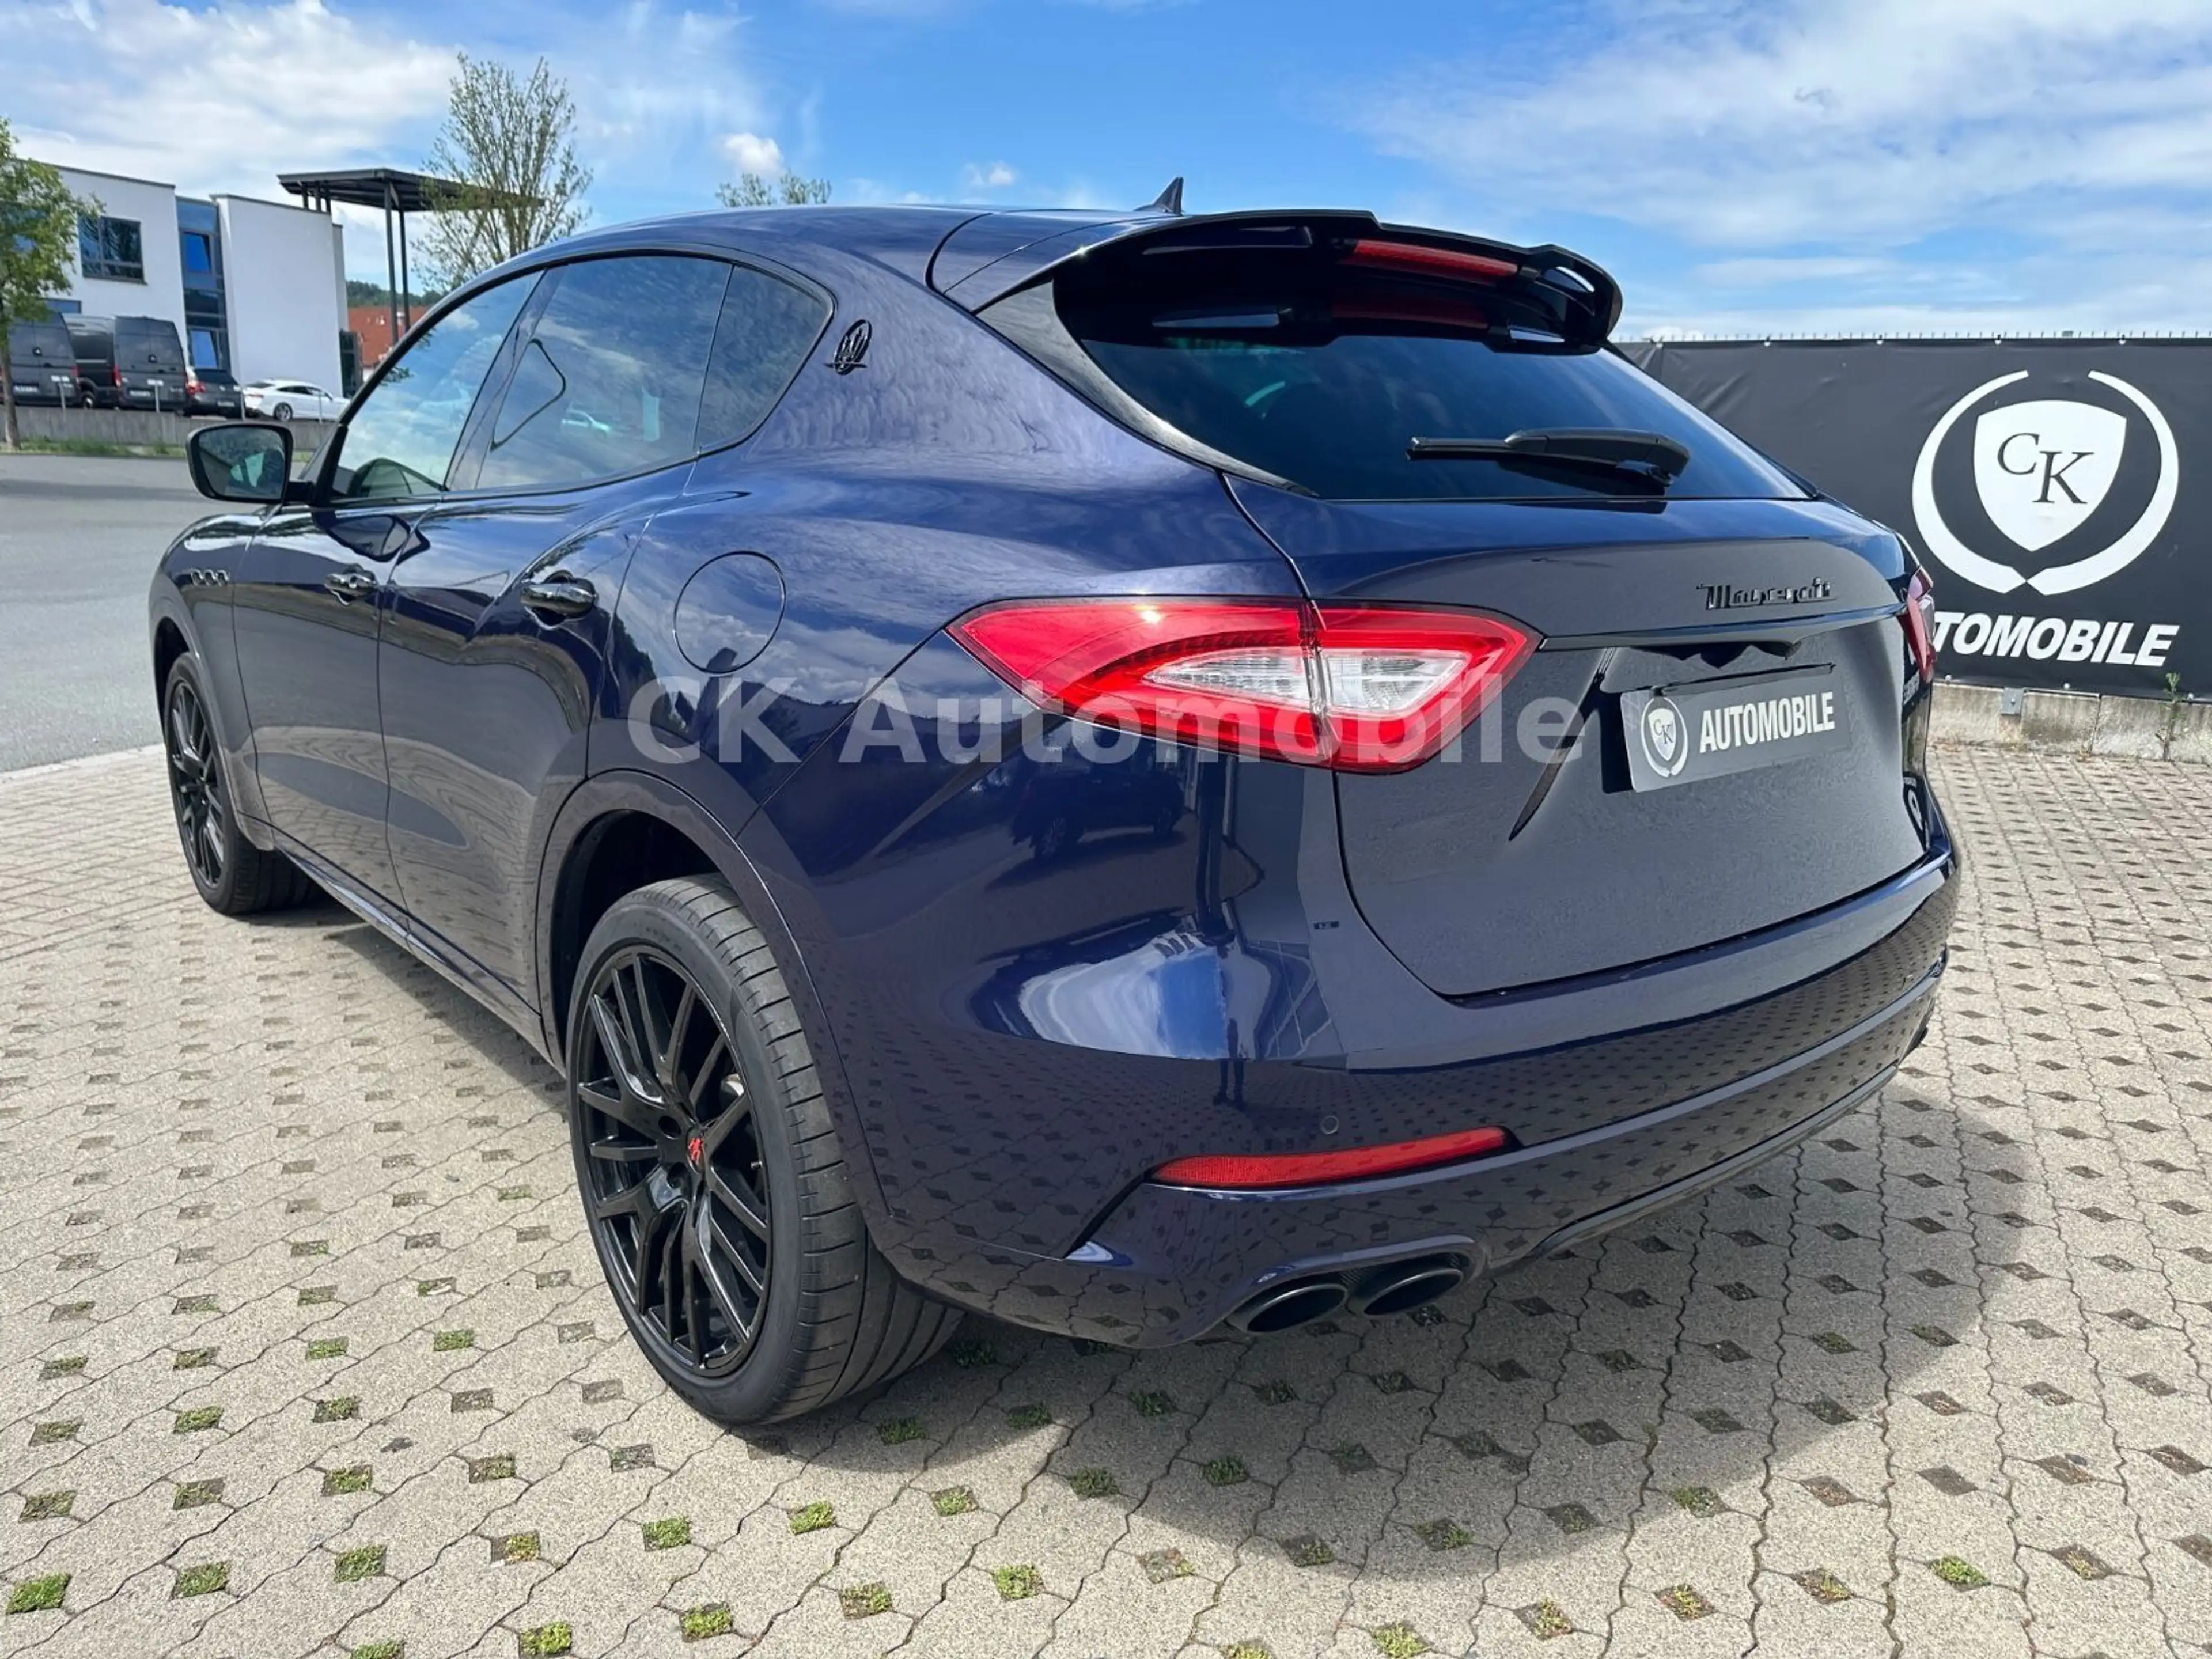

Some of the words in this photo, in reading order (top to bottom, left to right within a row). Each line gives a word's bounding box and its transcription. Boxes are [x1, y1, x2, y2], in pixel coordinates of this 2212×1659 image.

[1997, 432, 2095, 505] CK
[1932, 611, 2180, 667] TOMOBILE
[1653, 719, 1674, 744] CK
[1699, 691, 1836, 753] AUTOMOBILE
